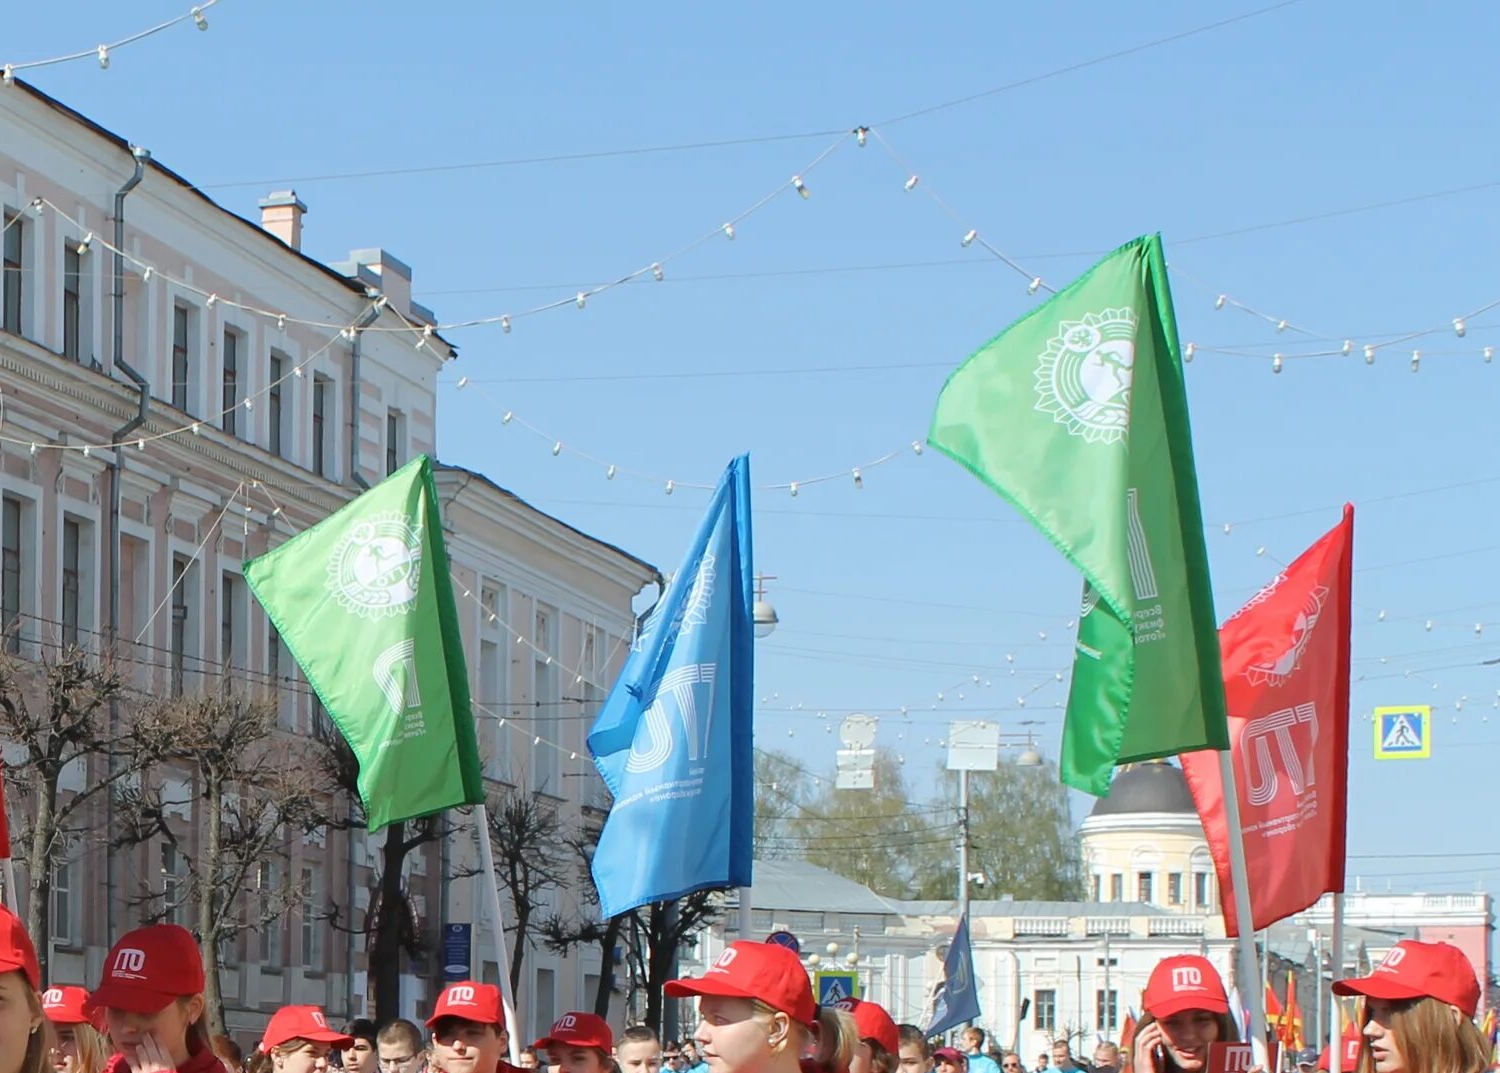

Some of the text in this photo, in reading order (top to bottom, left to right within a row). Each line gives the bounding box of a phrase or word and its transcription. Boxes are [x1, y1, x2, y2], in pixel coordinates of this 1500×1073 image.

[114, 948, 146, 972] ГТО
[1172, 966, 1202, 986] ГТО
[448, 986, 475, 1003] ГТО
